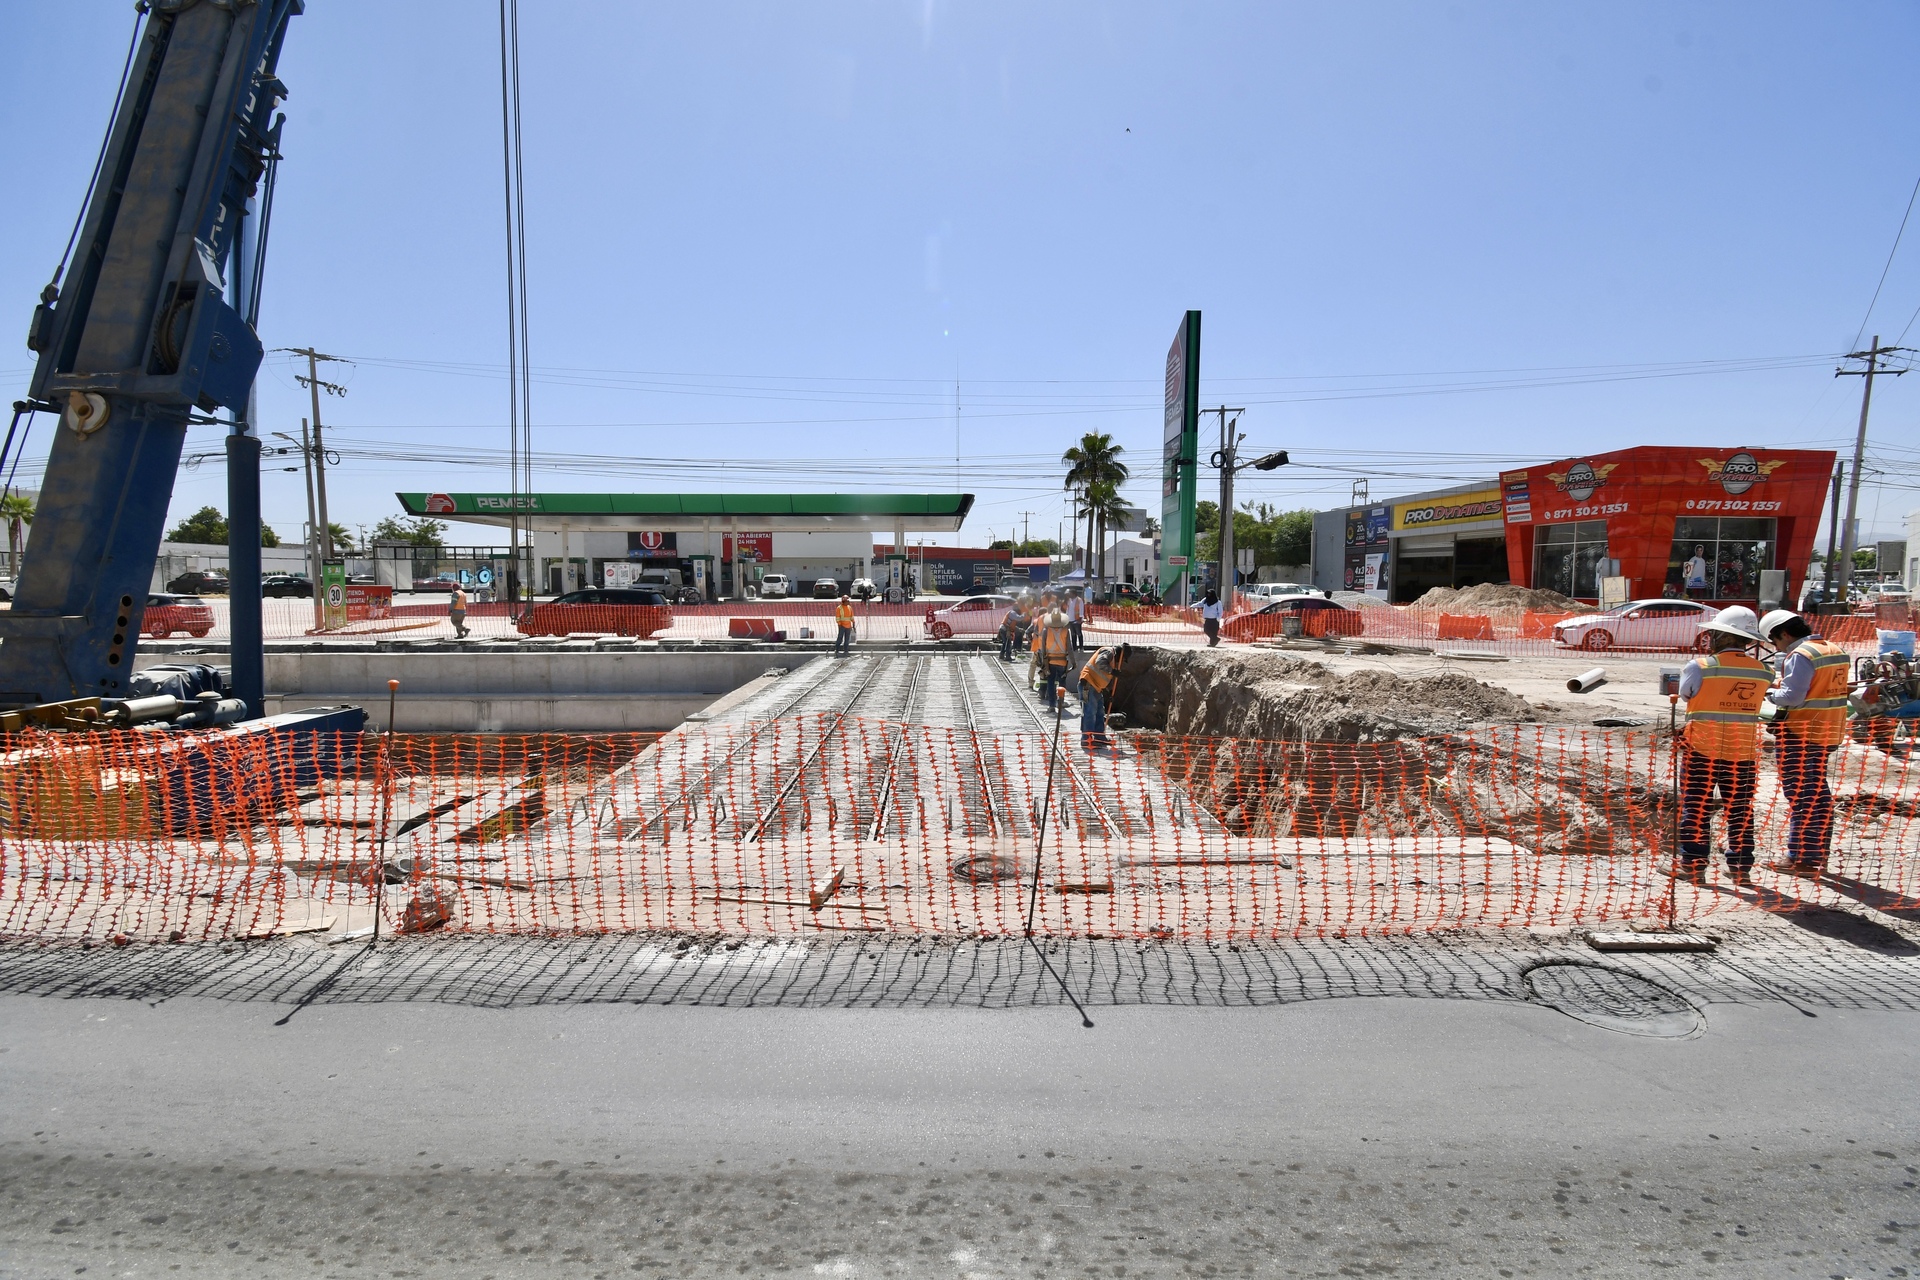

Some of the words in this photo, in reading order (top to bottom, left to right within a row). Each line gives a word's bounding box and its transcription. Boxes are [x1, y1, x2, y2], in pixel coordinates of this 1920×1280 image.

[1166, 400, 1183, 422] PEMEX
[1725, 464, 1757, 473] PRO
[1568, 472, 1592, 482] PRO
[477, 497, 538, 508] PEMEX
[1696, 500, 1723, 510] 871
[1722, 501, 1750, 510] 302
[1752, 501, 1782, 511] 1351
[1554, 509, 1572, 519] 871
[1575, 506, 1599, 517] 302
[1601, 502, 1629, 515] 1351
[331, 589, 341, 602] 30
